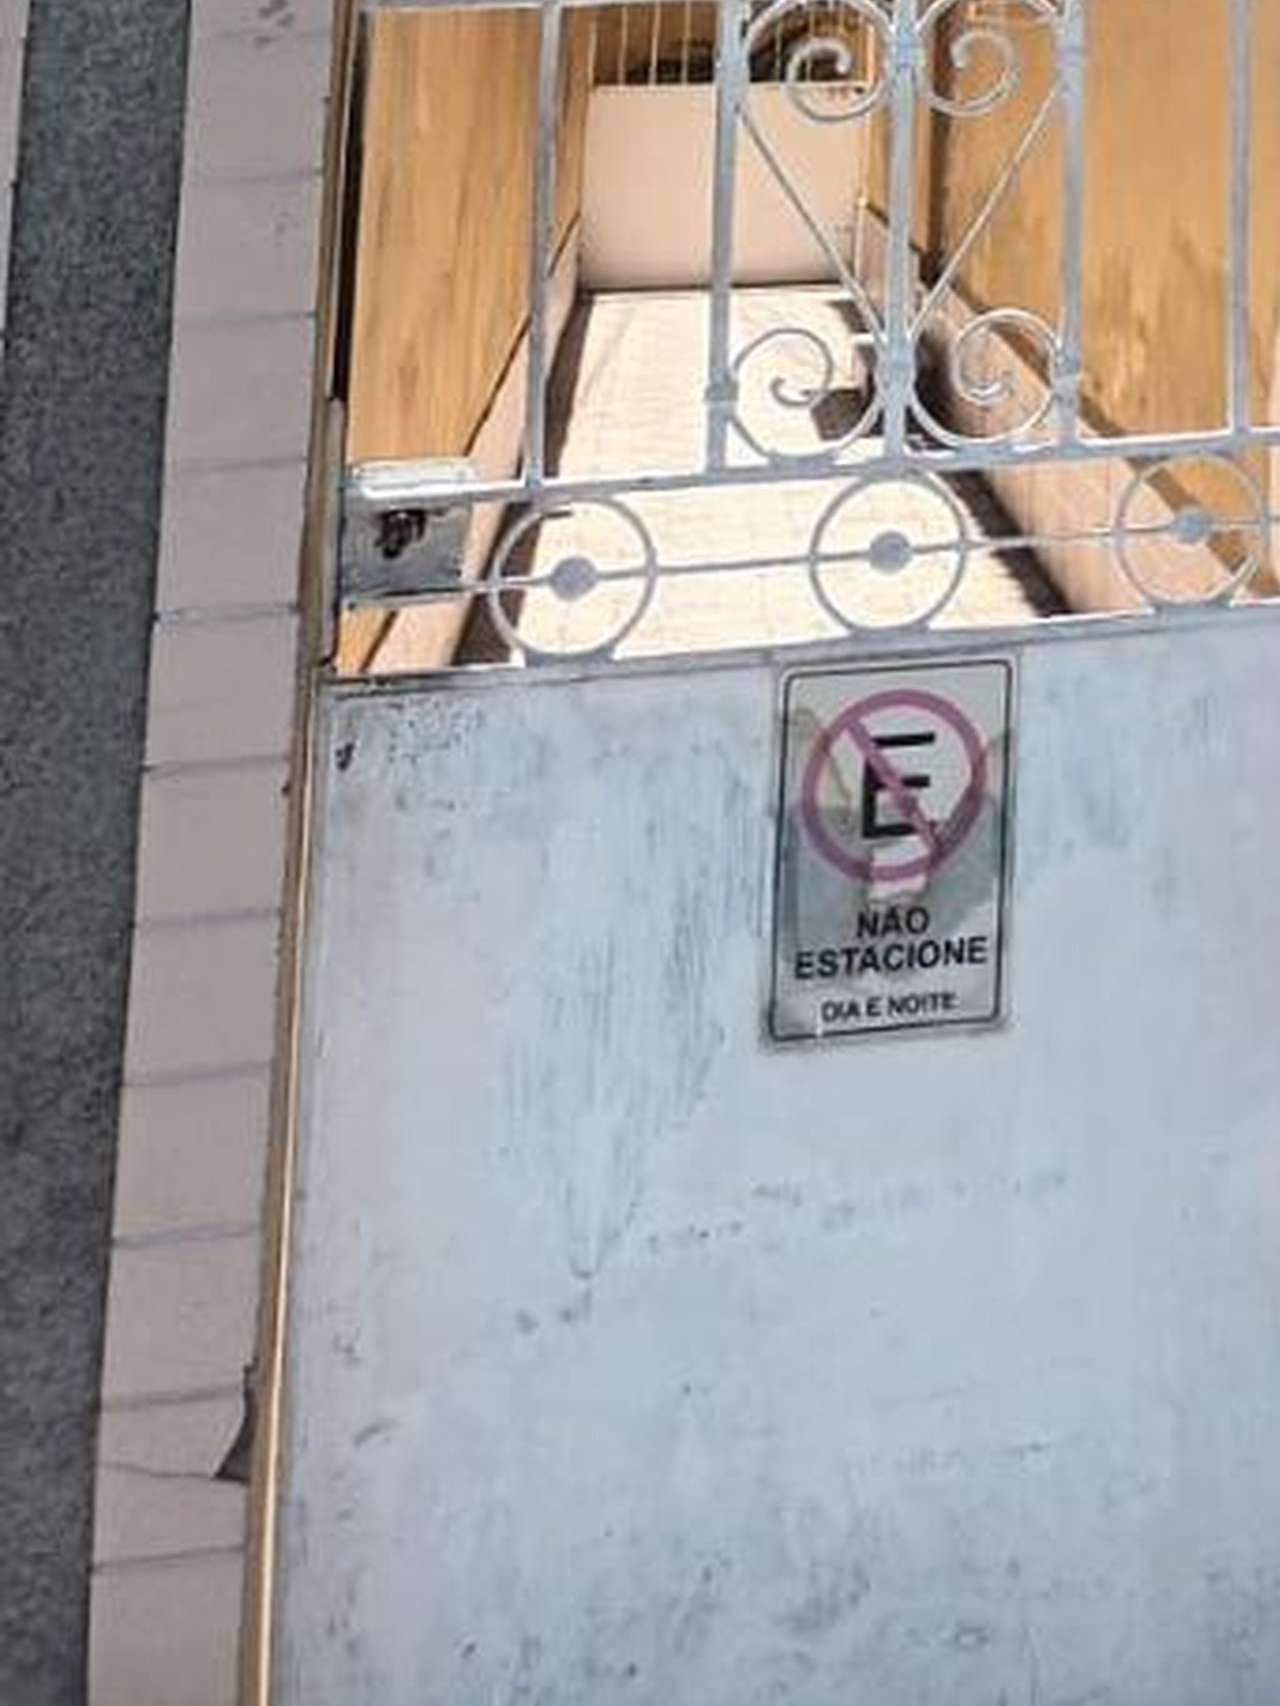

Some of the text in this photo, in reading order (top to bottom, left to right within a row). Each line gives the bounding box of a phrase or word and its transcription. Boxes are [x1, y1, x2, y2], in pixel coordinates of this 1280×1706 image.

[794, 935, 989, 979] ESTACIONE
[821, 991, 958, 1023] DIA E NOITE
